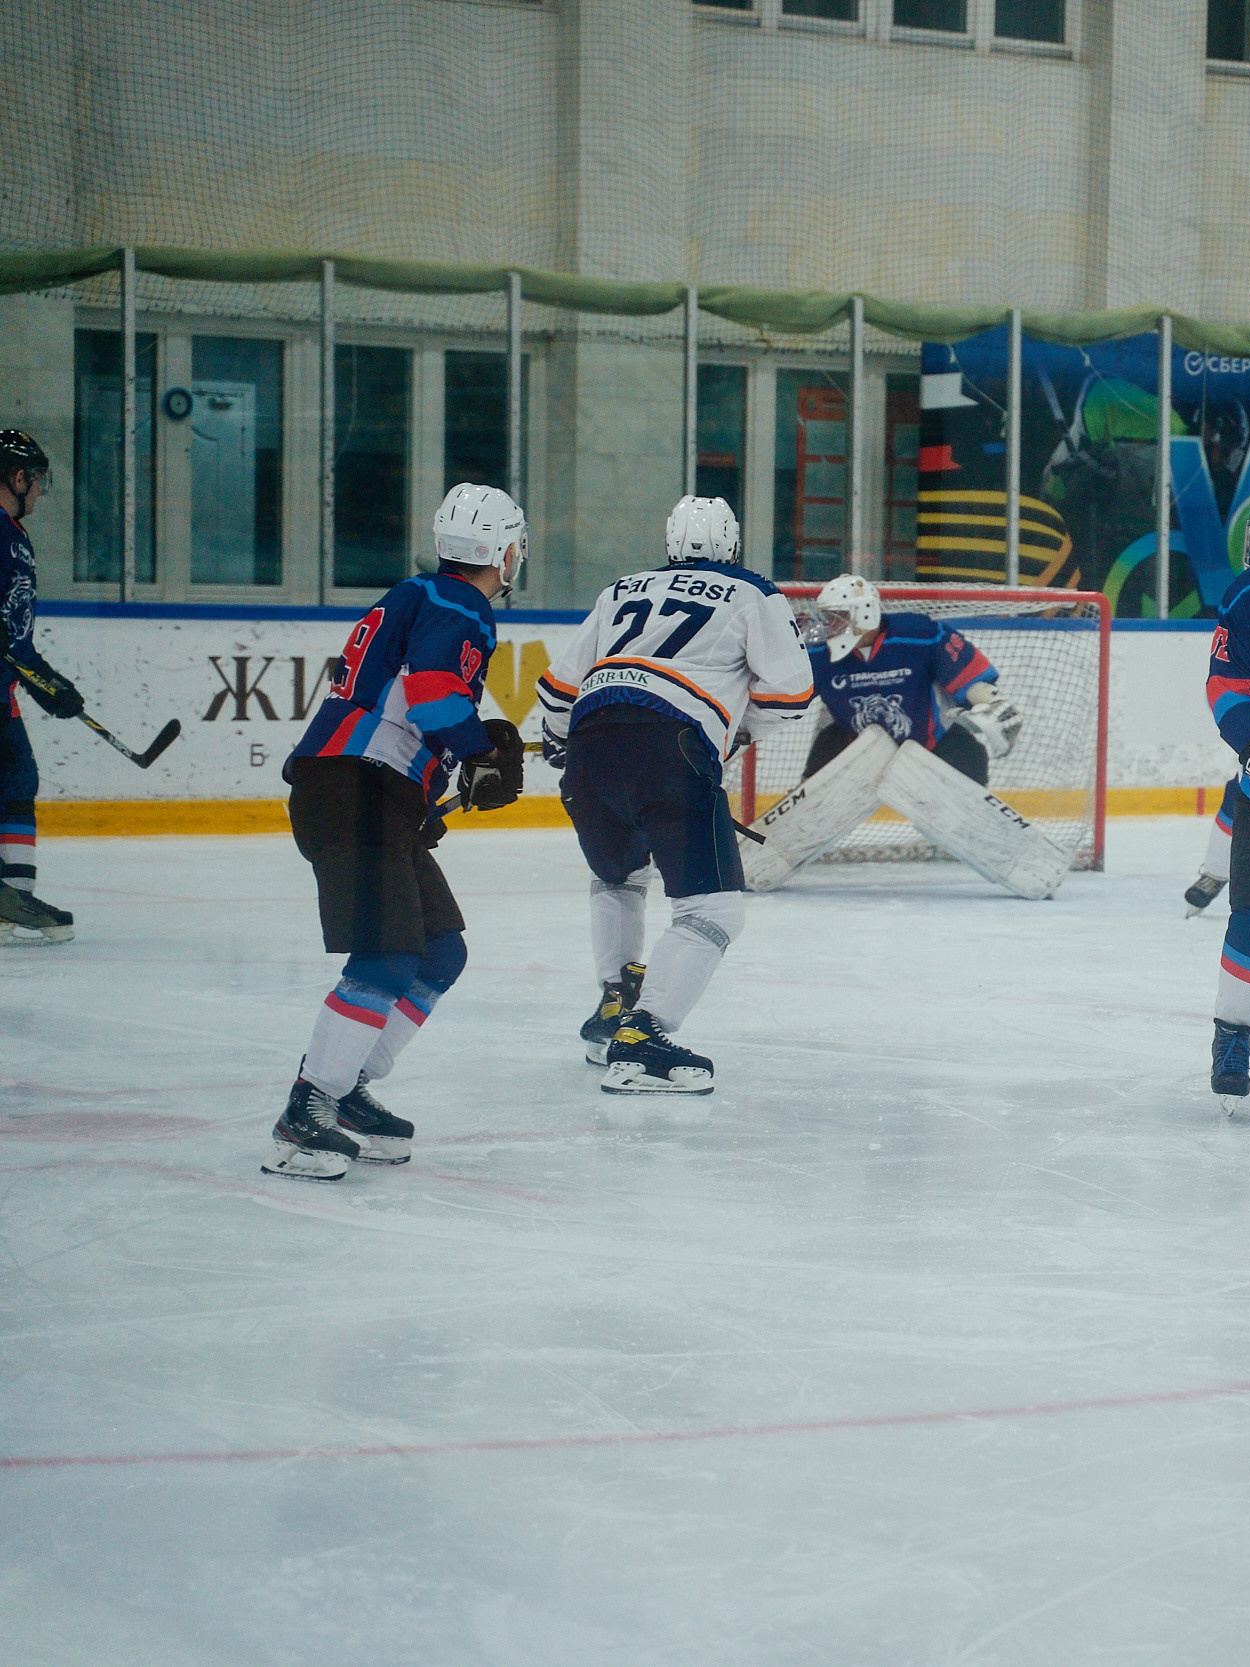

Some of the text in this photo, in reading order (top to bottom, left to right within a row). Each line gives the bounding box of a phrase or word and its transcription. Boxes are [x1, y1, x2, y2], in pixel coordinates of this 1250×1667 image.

[612, 574, 737, 603] Far East
[606, 598, 717, 659] 27
[461, 639, 483, 683] 19
[763, 787, 807, 826] CCM
[984, 793, 1031, 829] CCM
